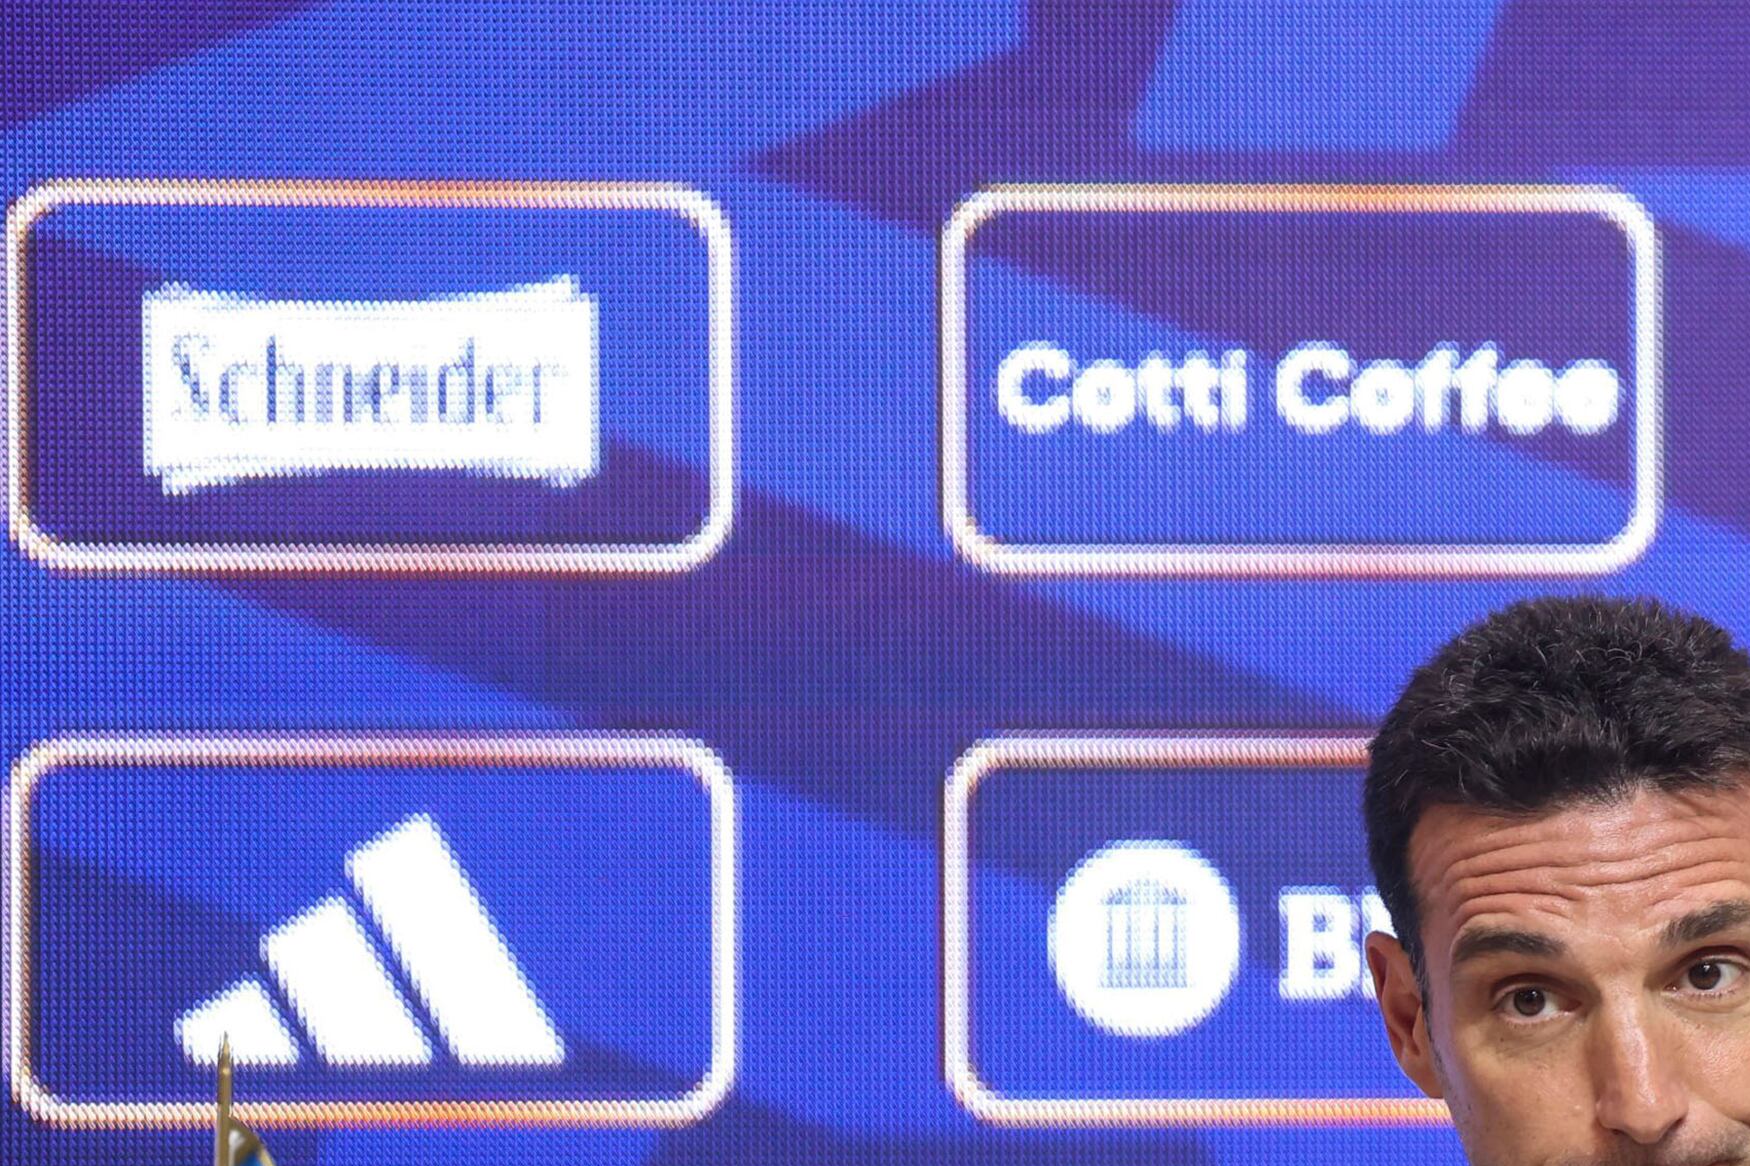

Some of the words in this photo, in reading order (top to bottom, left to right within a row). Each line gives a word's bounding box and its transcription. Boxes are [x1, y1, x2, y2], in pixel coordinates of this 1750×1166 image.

[172, 331, 568, 427] Schneider
[998, 340, 1248, 434] Cotti
[1275, 340, 1622, 434] Coffee
